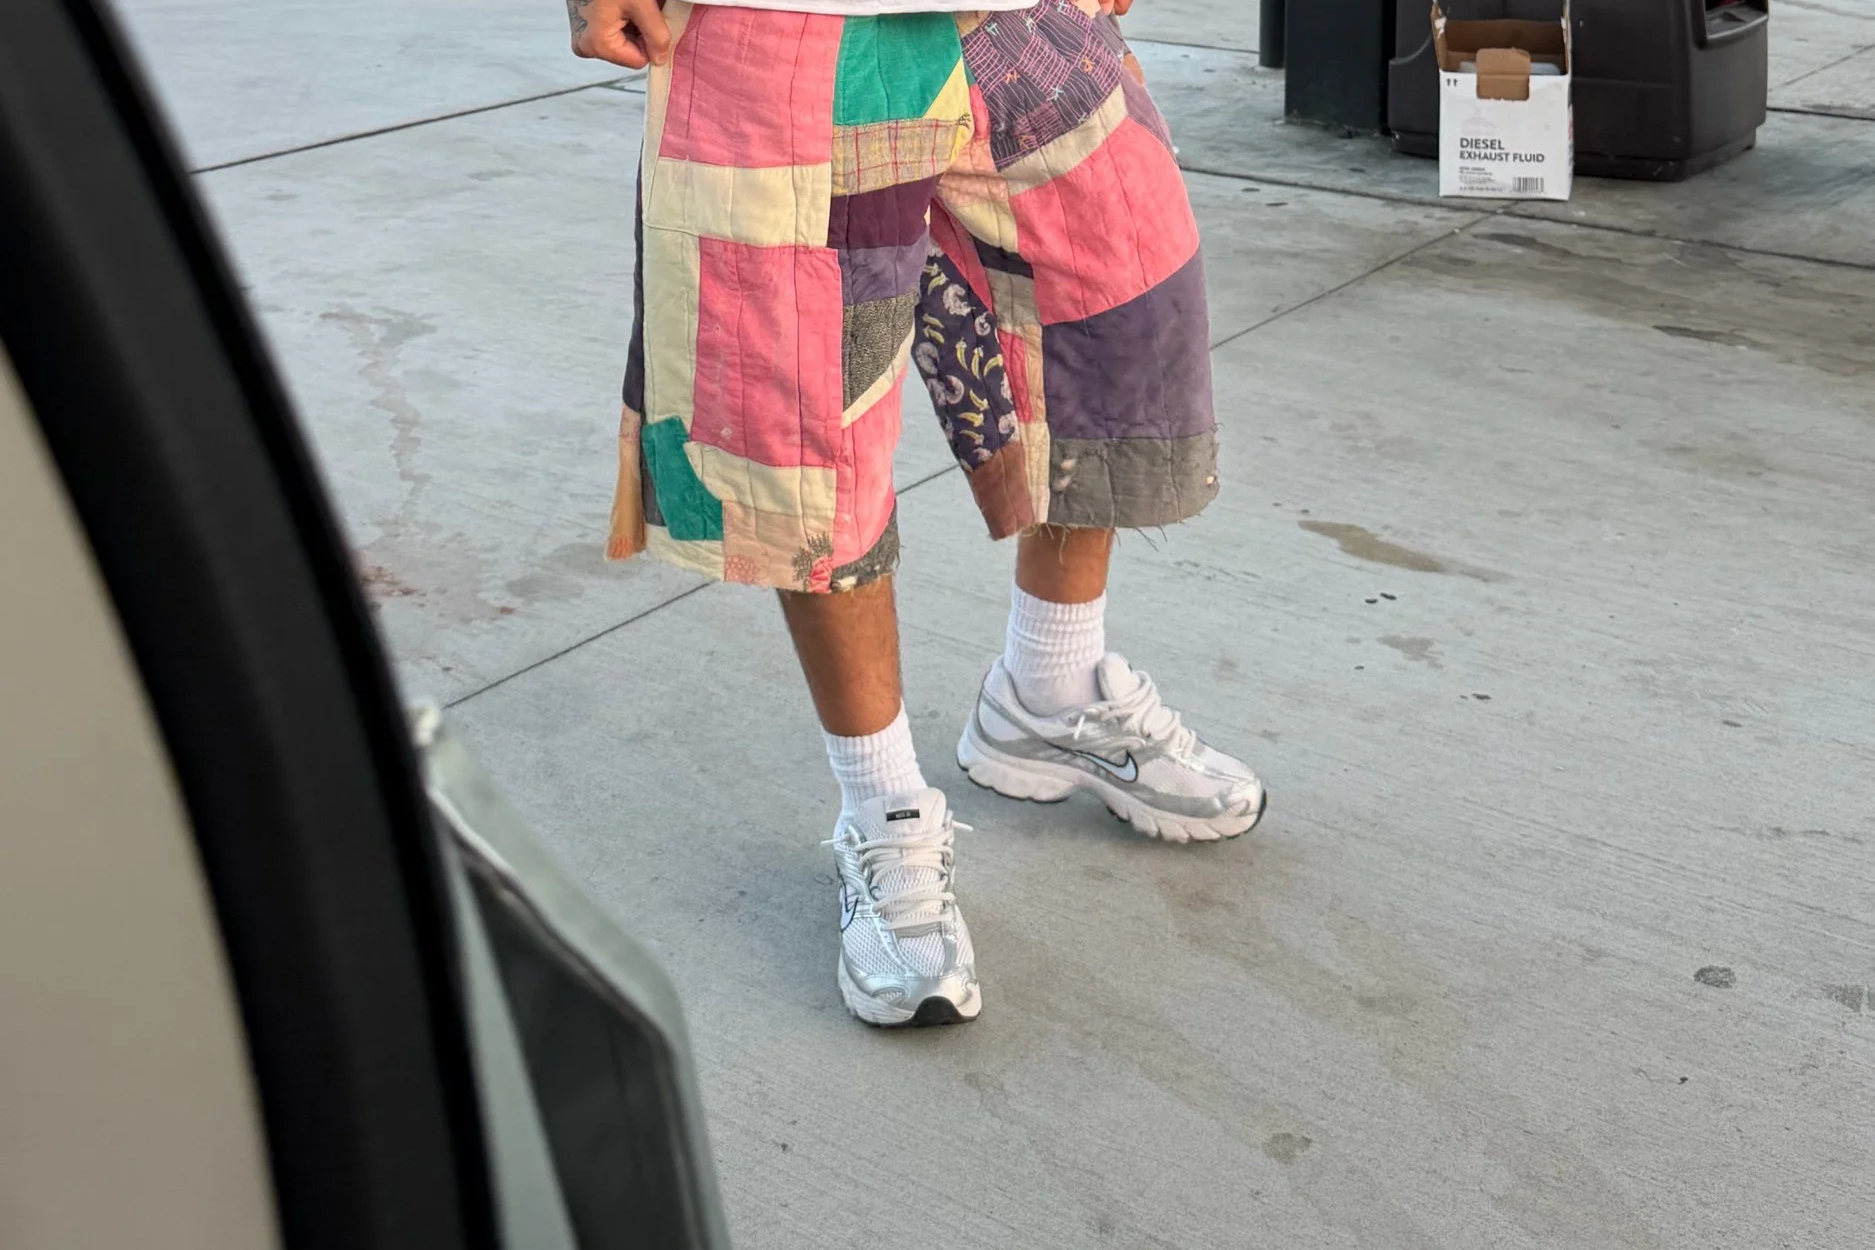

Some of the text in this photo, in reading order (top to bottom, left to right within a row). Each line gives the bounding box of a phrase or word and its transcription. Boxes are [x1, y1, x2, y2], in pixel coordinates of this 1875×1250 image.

[1459, 137, 1505, 151] DIESEL
[1459, 150, 1545, 163] EXHAUST FLUID
